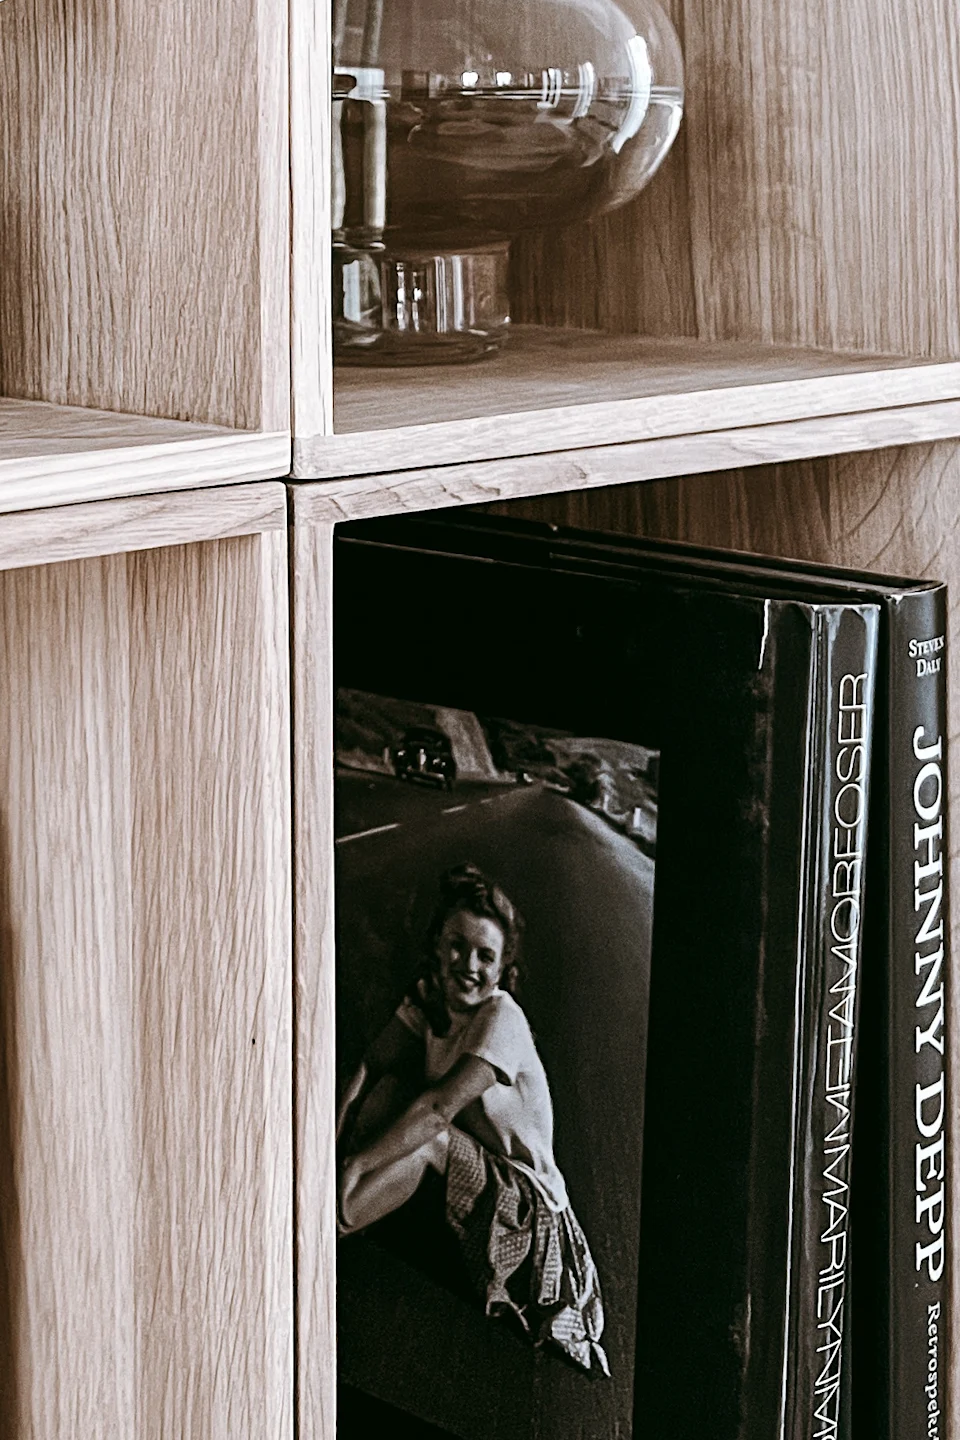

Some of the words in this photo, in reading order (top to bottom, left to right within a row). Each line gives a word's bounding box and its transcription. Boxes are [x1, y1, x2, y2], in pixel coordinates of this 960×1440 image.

[823, 671, 868, 1142] METAMORFOSER
[912, 725, 945, 1055] JOHNNY
[914, 1071, 945, 1283] DEPP
[924, 1301, 941, 1440] Retrospekt
